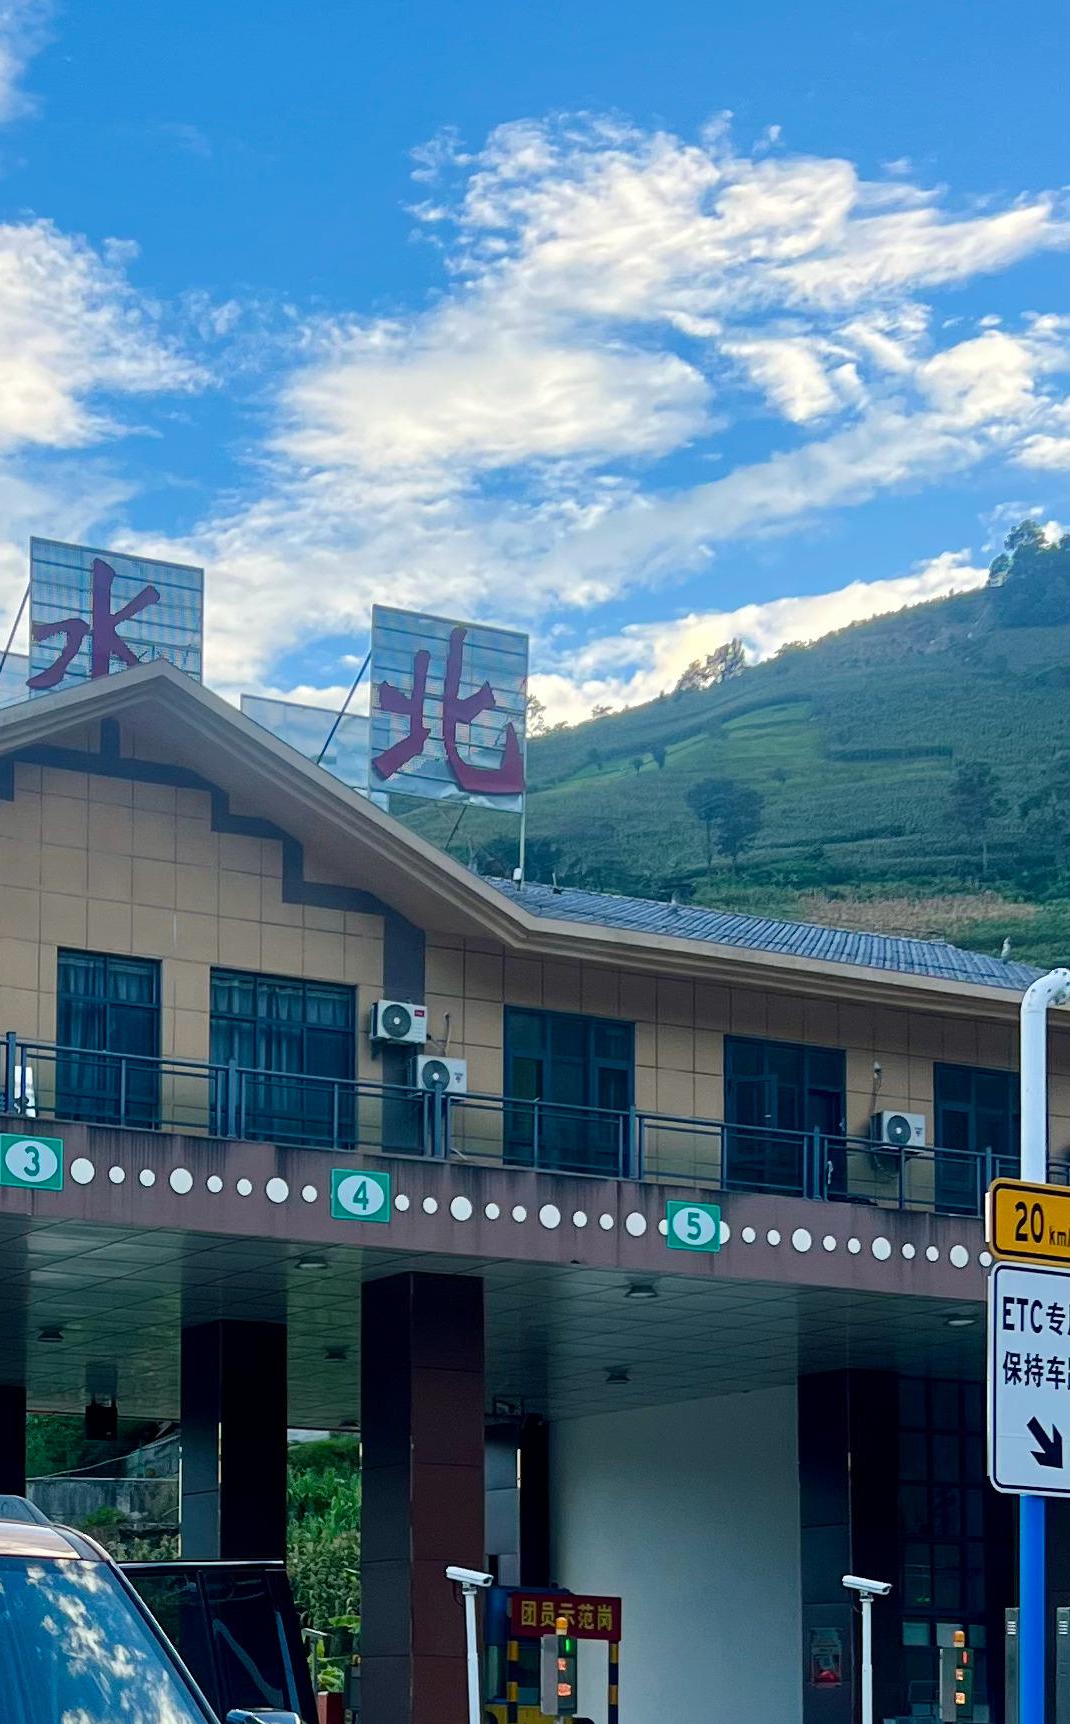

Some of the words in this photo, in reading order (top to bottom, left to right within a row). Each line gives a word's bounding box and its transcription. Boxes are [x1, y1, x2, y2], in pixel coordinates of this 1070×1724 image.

[23, 1145, 41, 1177] 3
[352, 1181, 370, 1211] 4
[687, 1212, 702, 1240] 5
[1015, 1201, 1045, 1244] 20
[1003, 1296, 1070, 1335] ETC专
[1003, 1351, 1070, 1390] 保持车
[521, 1600, 613, 1631] 团员示范岗
